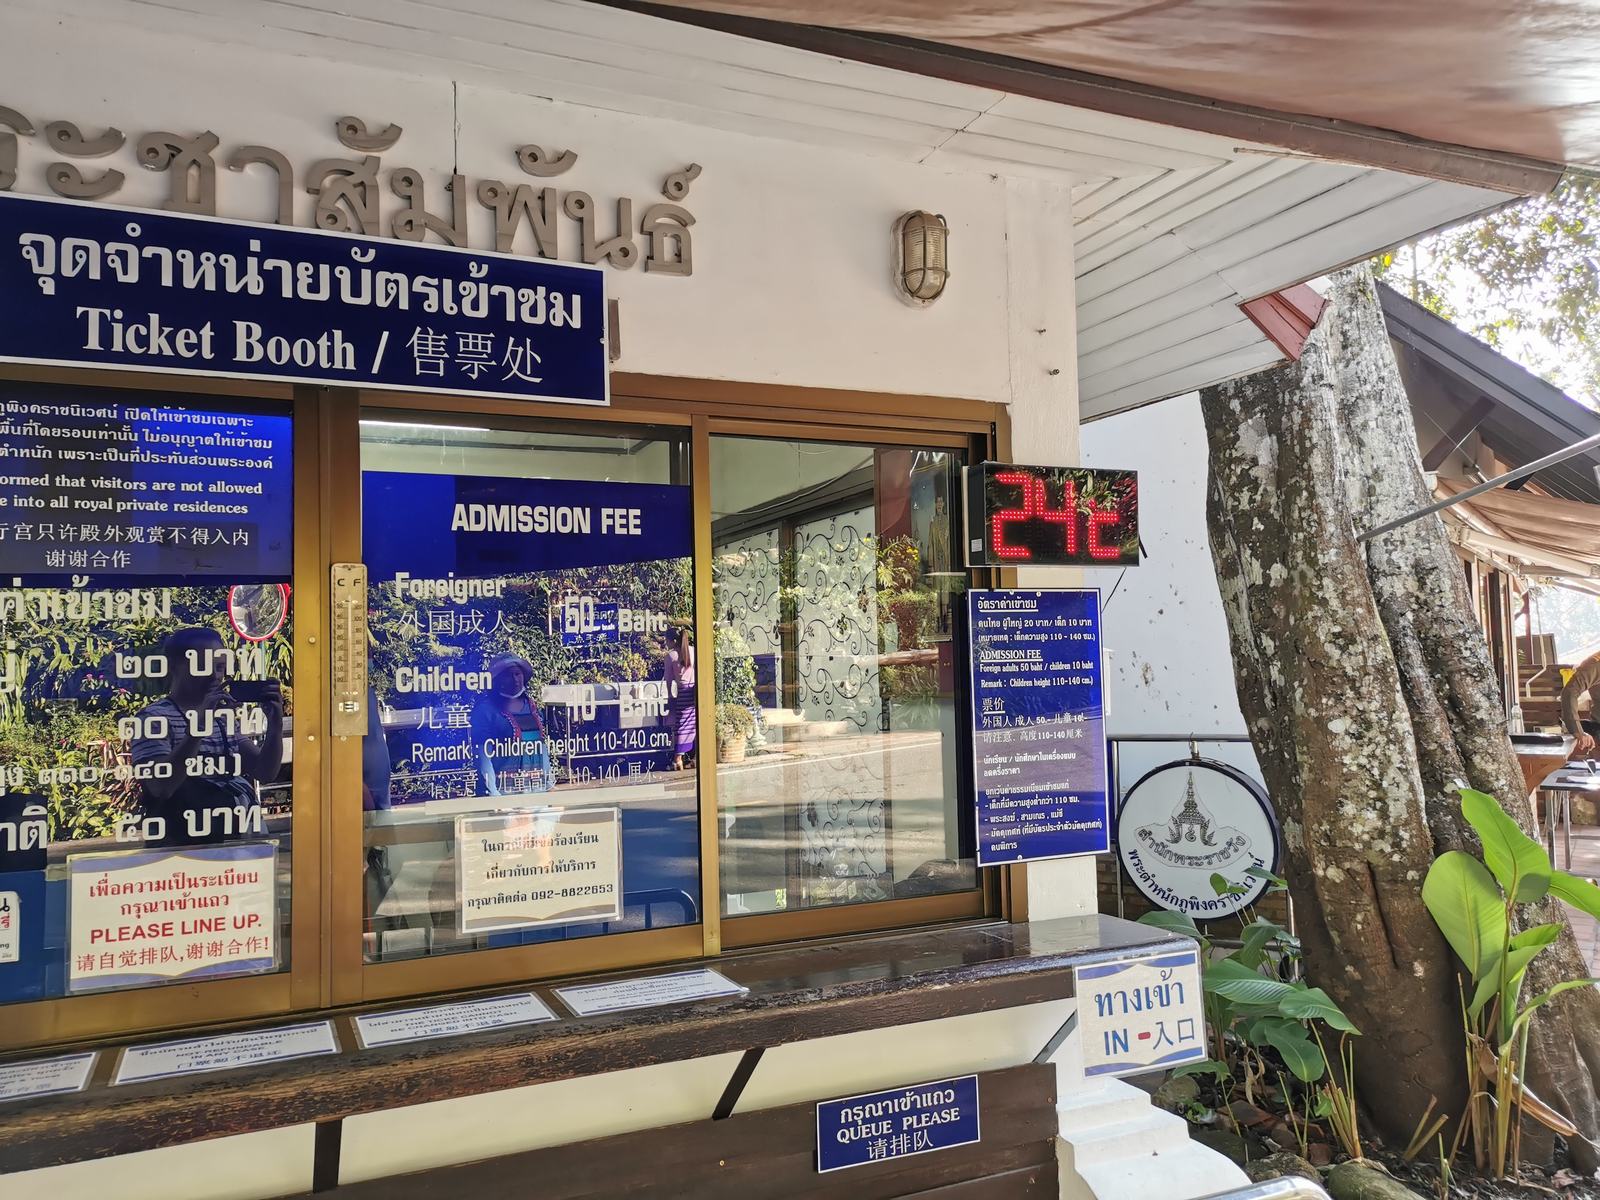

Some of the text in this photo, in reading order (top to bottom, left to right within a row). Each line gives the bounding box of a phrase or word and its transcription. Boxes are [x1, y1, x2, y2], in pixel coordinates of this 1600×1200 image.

[18, 222, 582, 329] จุดจำหน่ายบัตรเข้าชม
[76, 306, 544, 384] Ticket Booth / 售票处
[124, 406, 254, 427] เปิดให้เข้าชมเฉพาะ
[142, 426, 273, 449] ไม่อนุญาตให้เข้าชม
[58, 446, 273, 470] เพราะเป็นที่ประทับส่วนพระองค์
[55, 474, 86, 488] that
[91, 476, 147, 491] visitors
[152, 481, 176, 492] are
[181, 480, 203, 492] not
[208, 480, 263, 495] allowed
[13, 494, 45, 508] into
[50, 495, 69, 509] all
[74, 496, 113, 513] royal
[116, 499, 168, 513] private
[173, 500, 249, 515] residences
[451, 503, 641, 535] ADMISSION FEE
[45, 550, 131, 569] 谢谢合作
[353, 578, 361, 587] F
[395, 572, 507, 604] Foreigner
[564, 595, 594, 634] 50
[618, 608, 668, 633] Baht
[978, 596, 1037, 610] อัตราค่าเข้าชม
[398, 608, 513, 637] 外国成人
[978, 617, 1000, 628] คนไทย
[1024, 619, 1034, 627] 20
[1068, 618, 1078, 627] 10
[1079, 618, 1092, 627] บาท
[115, 648, 265, 679] ๒๐ บาท
[979, 649, 1042, 660] ADMISSION FEE
[980, 663, 1001, 674] Foreign
[1002, 663, 1019, 672] adults
[1020, 663, 1029, 671] 50
[1030, 662, 1043, 671] baht
[1049, 661, 1071, 671] children
[1072, 661, 1080, 670] 10
[1081, 660, 1094, 670] baht
[395, 666, 492, 693] Children
[981, 679, 1003, 688] Remark
[1010, 678, 1033, 688] Children
[1034, 677, 1051, 688] height
[1052, 676, 1081, 686] 110-140
[416, 703, 472, 730] 儿童
[619, 692, 670, 718] Baht
[982, 697, 1005, 711] 票价
[185, 707, 265, 737] บาท
[982, 715, 1012, 728] 外国人
[1015, 714, 1034, 726] 成人
[1053, 712, 1072, 724] 儿童
[412, 740, 471, 763] Remark
[484, 735, 543, 758] Children
[548, 733, 590, 757] height
[593, 729, 646, 751] 110-140
[569, 763, 620, 788] 110-140
[1055, 796, 1068, 804] 110
[183, 804, 261, 837] บาท
[991, 841, 1018, 852] คนพิการ
[1137, 827, 1247, 867] สำนักพระราชวัง
[89, 867, 259, 898] เพื่อความเป็นระเบียบ
[486, 858, 597, 880] เกี่ยวกับการให้บริการ
[120, 892, 230, 919] กรุณาเข้าแถว
[468, 884, 613, 909] กรุณาติดต่อ 092-8822653
[90, 913, 262, 944] PLEASE LINE UP.
[1094, 968, 1185, 1018] ทางเข้า
[1104, 1028, 1129, 1056] IN
[1152, 1017, 1195, 1051] 入口
[840, 1086, 956, 1125] กรุณาเข้าแถว
[836, 1107, 961, 1144] QUEUE PLEASE
[866, 1129, 934, 1161] 请排队
